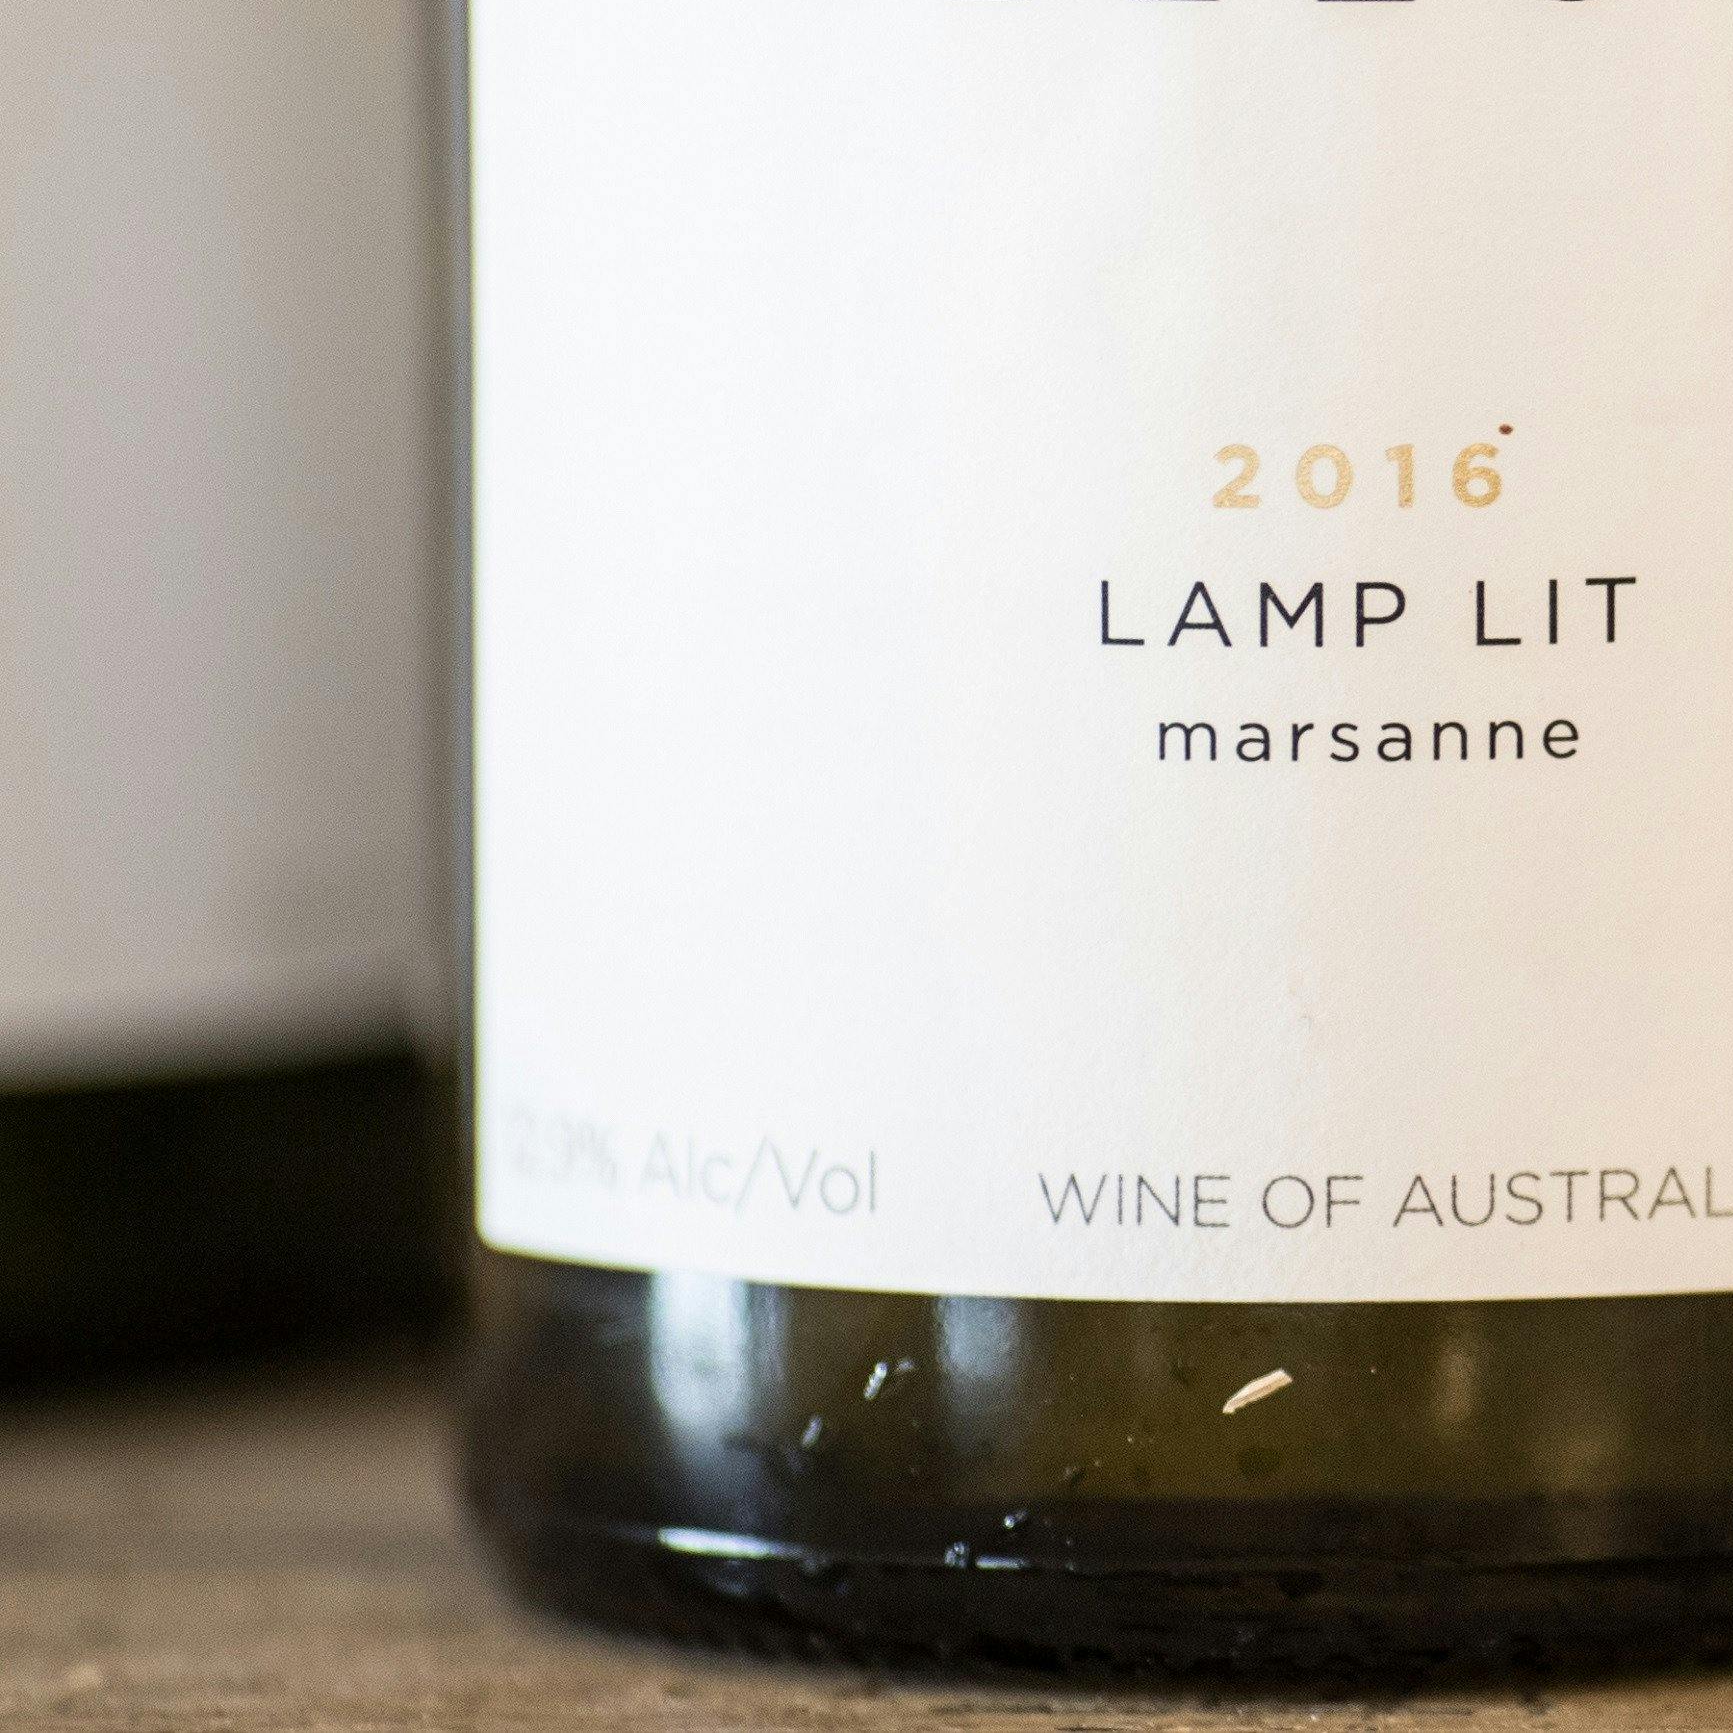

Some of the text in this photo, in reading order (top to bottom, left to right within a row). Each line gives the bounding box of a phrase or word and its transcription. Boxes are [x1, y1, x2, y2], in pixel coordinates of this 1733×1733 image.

[1211, 442, 1504, 511] 2016
[1098, 574, 1640, 649] LAMP LIT
[1156, 714, 1582, 765] marsanne
[639, 1127, 877, 1217] Alc/Vol
[1037, 1172, 1232, 1229] WINE
[1261, 1174, 1366, 1230] OF
